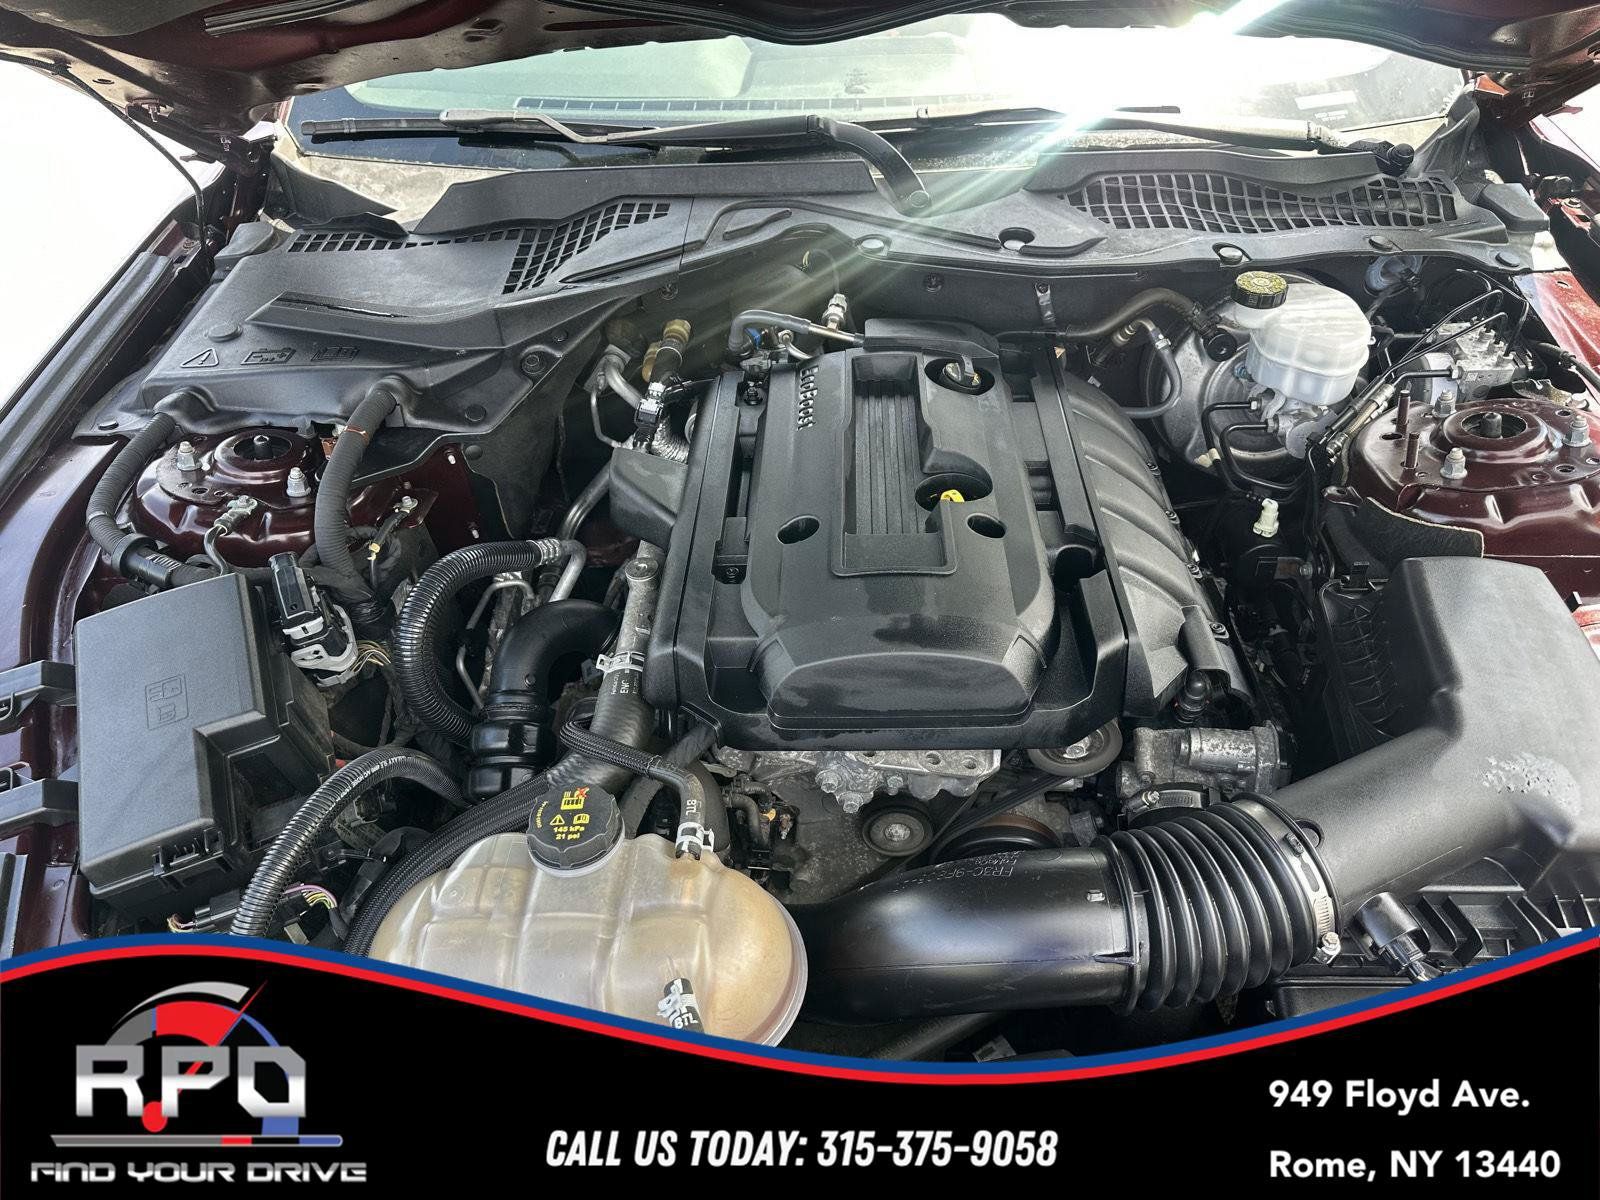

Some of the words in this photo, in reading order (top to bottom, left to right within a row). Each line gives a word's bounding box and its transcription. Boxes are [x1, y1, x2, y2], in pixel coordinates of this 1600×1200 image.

[797, 365, 819, 431] EcoBoost
[685, 799, 697, 817] BTL
[674, 1012, 699, 1030] BTL
